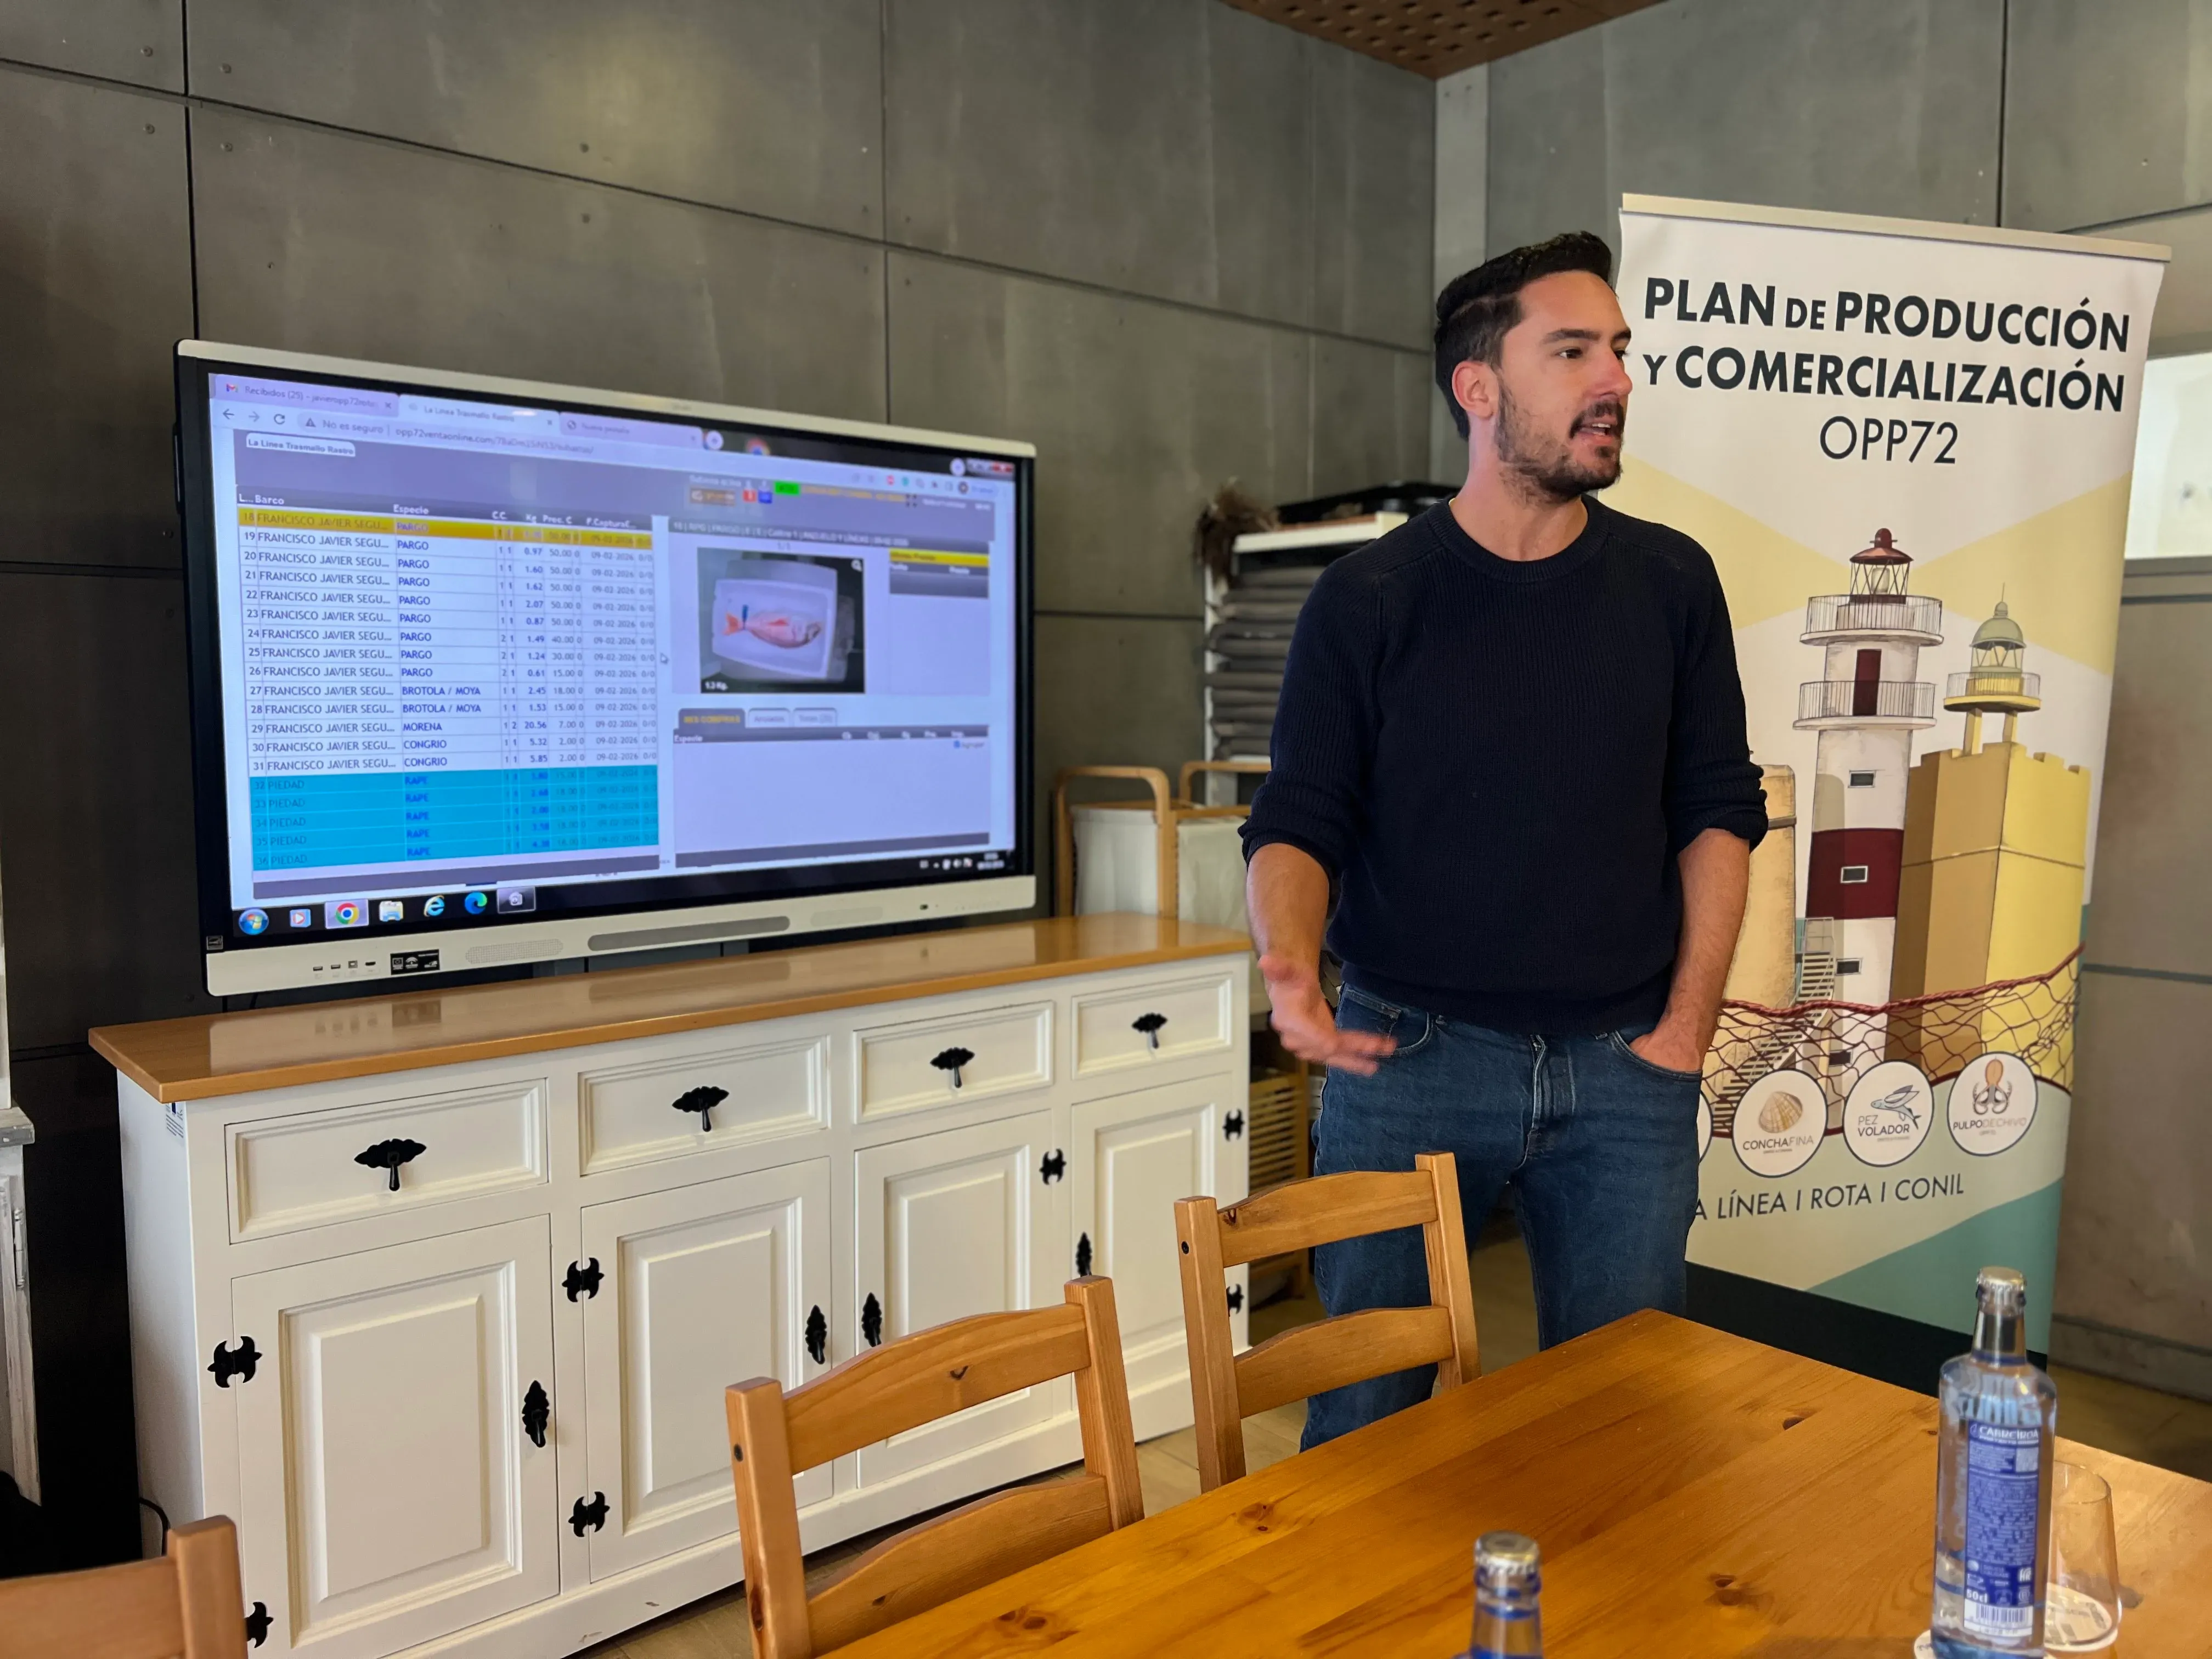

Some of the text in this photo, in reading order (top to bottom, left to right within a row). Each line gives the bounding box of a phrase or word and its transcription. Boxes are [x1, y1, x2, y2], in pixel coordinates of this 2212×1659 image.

[1645, 278, 2130, 353] PLAN DE PRODUCCIÓN
[1643, 346, 2124, 413] Y COMERCIALIZACIÓN
[245, 386, 285, 397] Recibidos
[287, 391, 303, 400] (25)
[323, 420, 336, 429] No
[352, 424, 383, 434] seguro
[1820, 415, 1959, 465] OPP72
[328, 446, 354, 454] Rastro
[255, 495, 284, 505] Barco
[393, 504, 428, 515] Especie
[244, 513, 255, 521] 18
[258, 514, 314, 526] FRANCISCO
[319, 517, 352, 528] JAVIER
[397, 522, 428, 533] PARGO
[244, 532, 255, 540] 19
[258, 532, 315, 544] FRANCISCO
[319, 536, 352, 546] JAVIER
[397, 540, 429, 550] PARGO
[244, 551, 256, 560] 20
[258, 552, 316, 563] FRANCISCO
[320, 555, 353, 566] JAVIER
[398, 559, 430, 569] PARGO
[245, 571, 256, 579] 21
[259, 571, 317, 583] FRANCISCO
[320, 574, 353, 584] JAVIER
[398, 577, 430, 587] PARGO
[246, 590, 257, 599] 22
[261, 590, 318, 601] FRANCISCO
[321, 592, 354, 603] JAVIER
[399, 596, 431, 606] PARGO
[247, 610, 258, 618] 23
[261, 610, 318, 620] FRANCISCO
[321, 612, 354, 621] JAVIER
[399, 614, 431, 624] PARGO
[248, 629, 259, 637] 24
[262, 629, 319, 640] FRANCISCO
[323, 631, 355, 640] JAVIER
[400, 633, 432, 642] PARGO
[249, 648, 259, 657] 25
[263, 648, 320, 658] FRANCISCO
[323, 649, 356, 658] JAVIER
[400, 650, 432, 659] PARGO
[249, 667, 261, 675] 26
[263, 667, 320, 676] FRANCISCO
[324, 667, 357, 676] JAVIER
[401, 668, 433, 678] PARGO
[250, 686, 262, 695] 27
[264, 686, 321, 695] FRANCISCO
[324, 686, 357, 695] JAVIER
[402, 686, 445, 696] BROTOLA
[456, 686, 481, 696] MOYA
[251, 705, 262, 714] 28
[265, 705, 321, 714] FRANCISCO
[325, 704, 358, 714] JAVIER
[403, 703, 445, 713] BROTOLA
[456, 703, 481, 713] MOYA
[251, 724, 263, 733] 29
[266, 724, 323, 733] FRANCISCO
[326, 724, 358, 732] JAVIER
[403, 721, 442, 731] MORENA
[252, 743, 264, 752] 30
[267, 742, 323, 752] FRANCISCO
[326, 741, 359, 751] JAVIER
[404, 740, 447, 749] CONGRIO
[253, 762, 264, 770] 31
[267, 760, 324, 771] FRANCISCO
[327, 759, 360, 769] JAVIER
[404, 757, 447, 766] CONGRIO
[268, 776, 428, 790] PIEDAD RAPE
[269, 793, 428, 808] PIEDAD RAPE
[269, 811, 429, 827] PIEDAD RAPE
[270, 829, 430, 846] PIEDAD RAPE
[271, 847, 431, 865] PIEDAD RAPE
[1858, 1115, 1878, 1125] PEZ
[1858, 1124, 1910, 1137] VOLADOR
[1742, 1135, 1814, 1150] CONCHAFINA
[1718, 1189, 1787, 1219] LÍNEA
[1810, 1184, 1872, 1210] ROTA
[1895, 1173, 1964, 1201] CONIL
